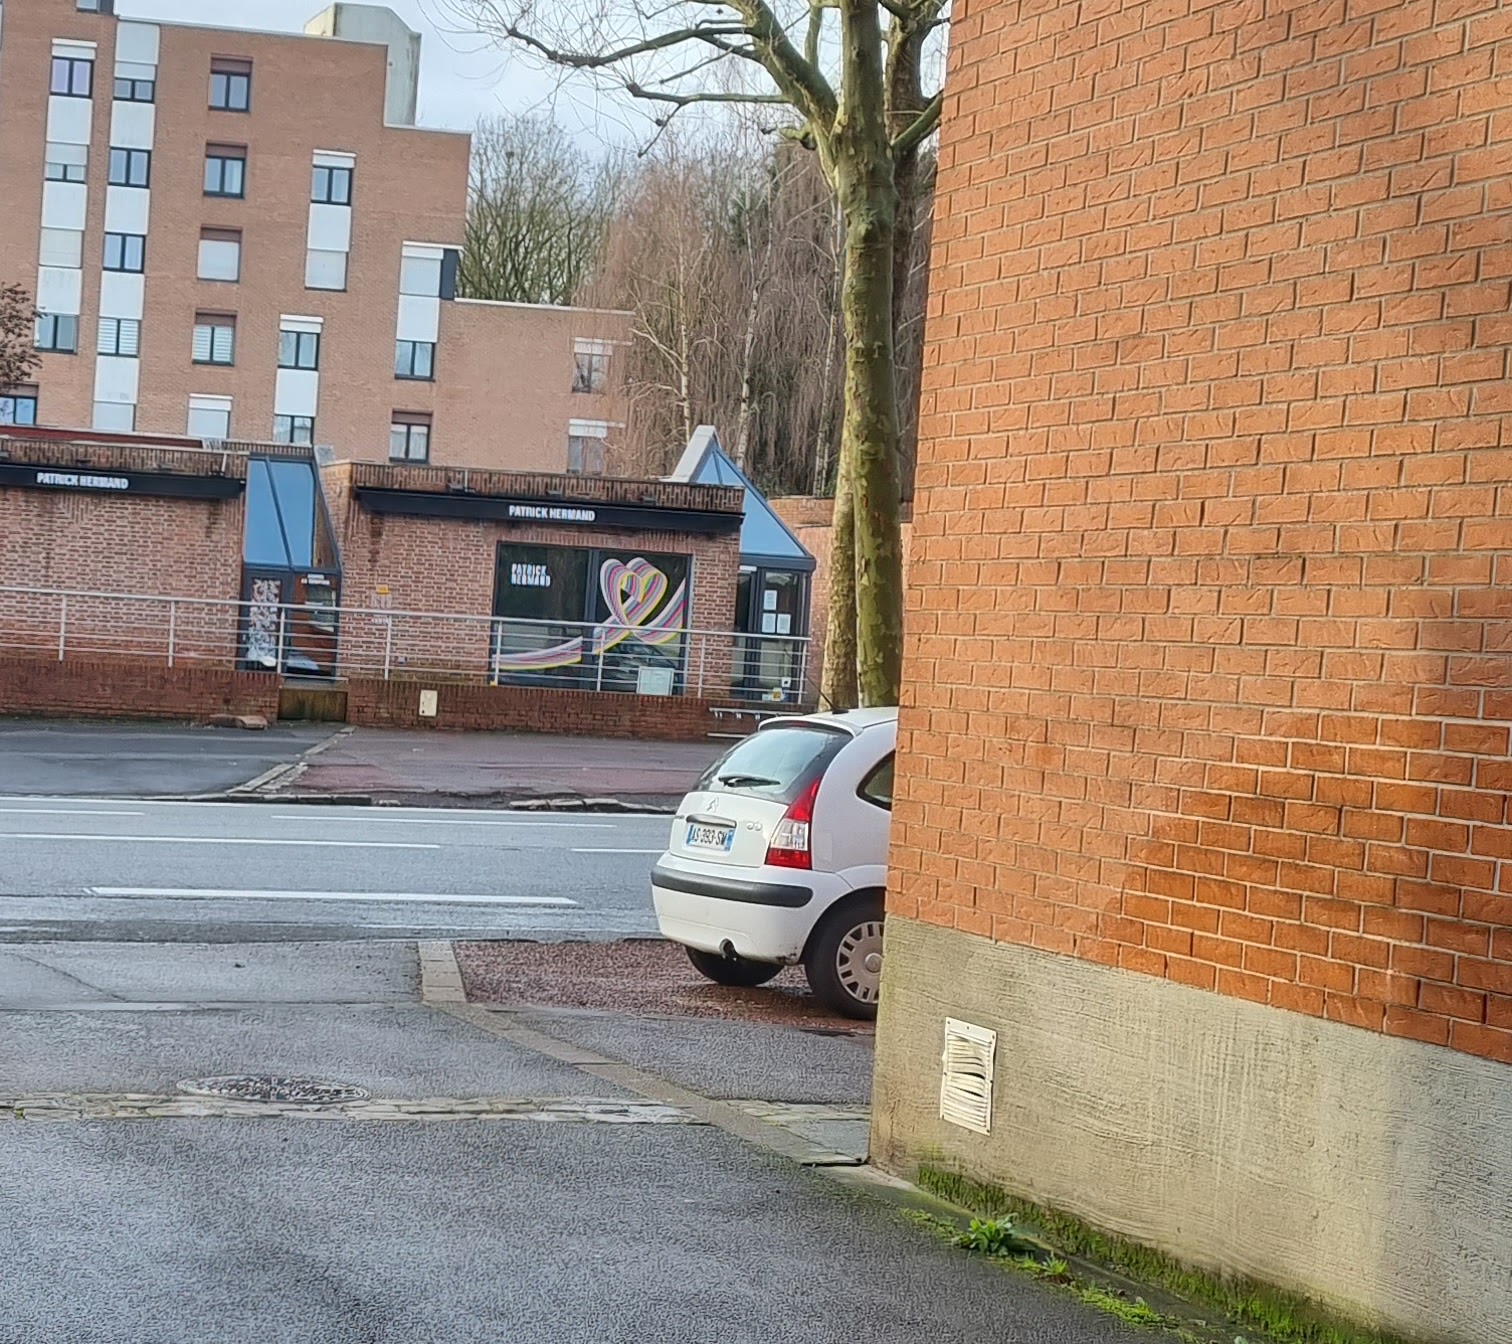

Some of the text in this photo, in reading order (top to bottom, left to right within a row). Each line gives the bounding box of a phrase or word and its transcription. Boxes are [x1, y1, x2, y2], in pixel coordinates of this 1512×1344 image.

[37, 472, 79, 486] PATRICK
[509, 505, 596, 521] PATRICK HERMAND
